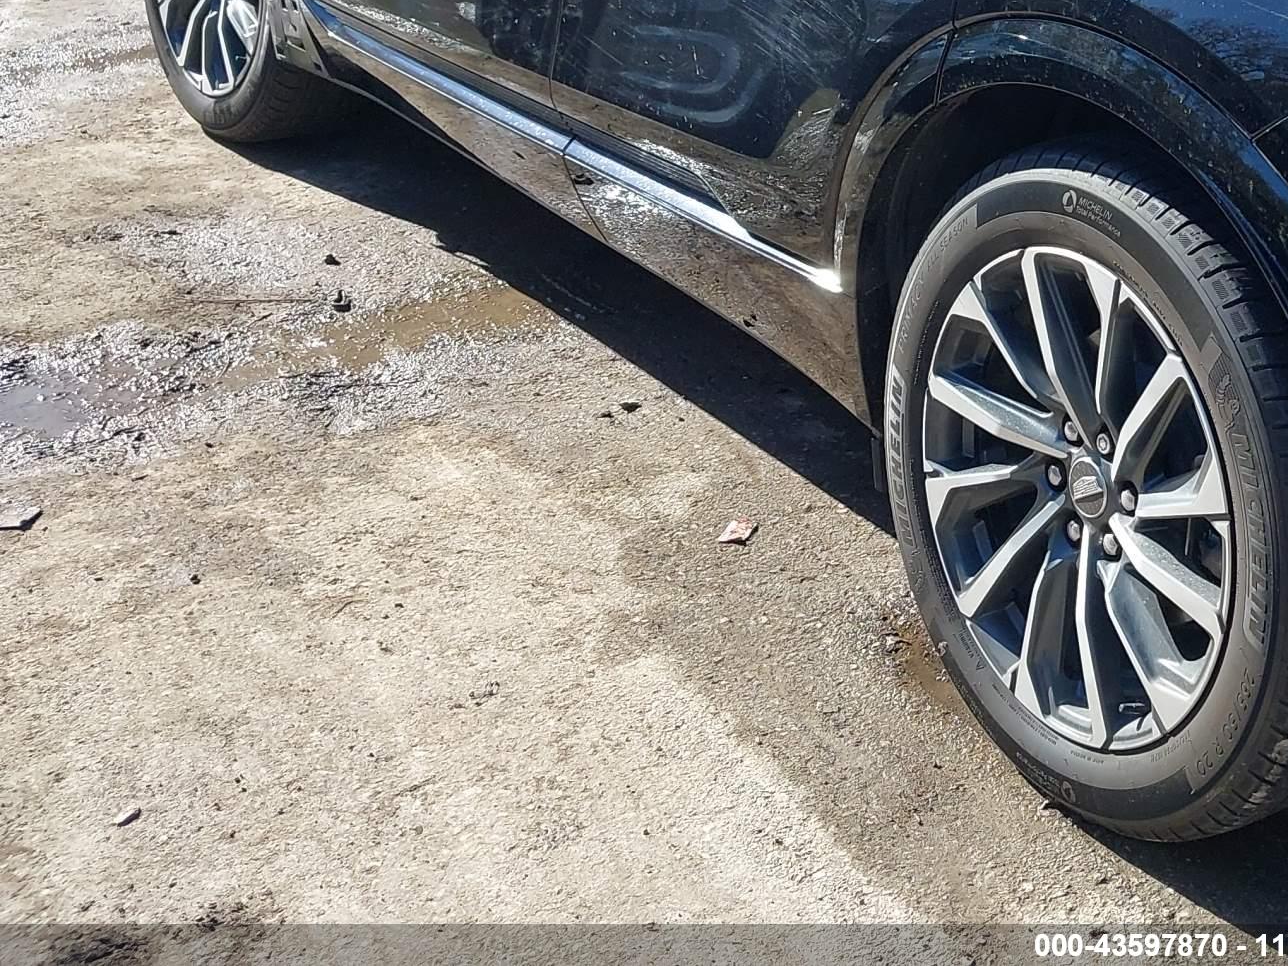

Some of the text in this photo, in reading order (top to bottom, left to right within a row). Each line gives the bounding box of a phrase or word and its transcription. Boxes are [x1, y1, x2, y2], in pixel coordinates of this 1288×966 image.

[938, 217, 969, 253] SEASON
[1078, 196, 1113, 221] MICHELIN
[888, 376, 914, 547] MICHELIN
[1230, 433, 1269, 646] MICHELIN
